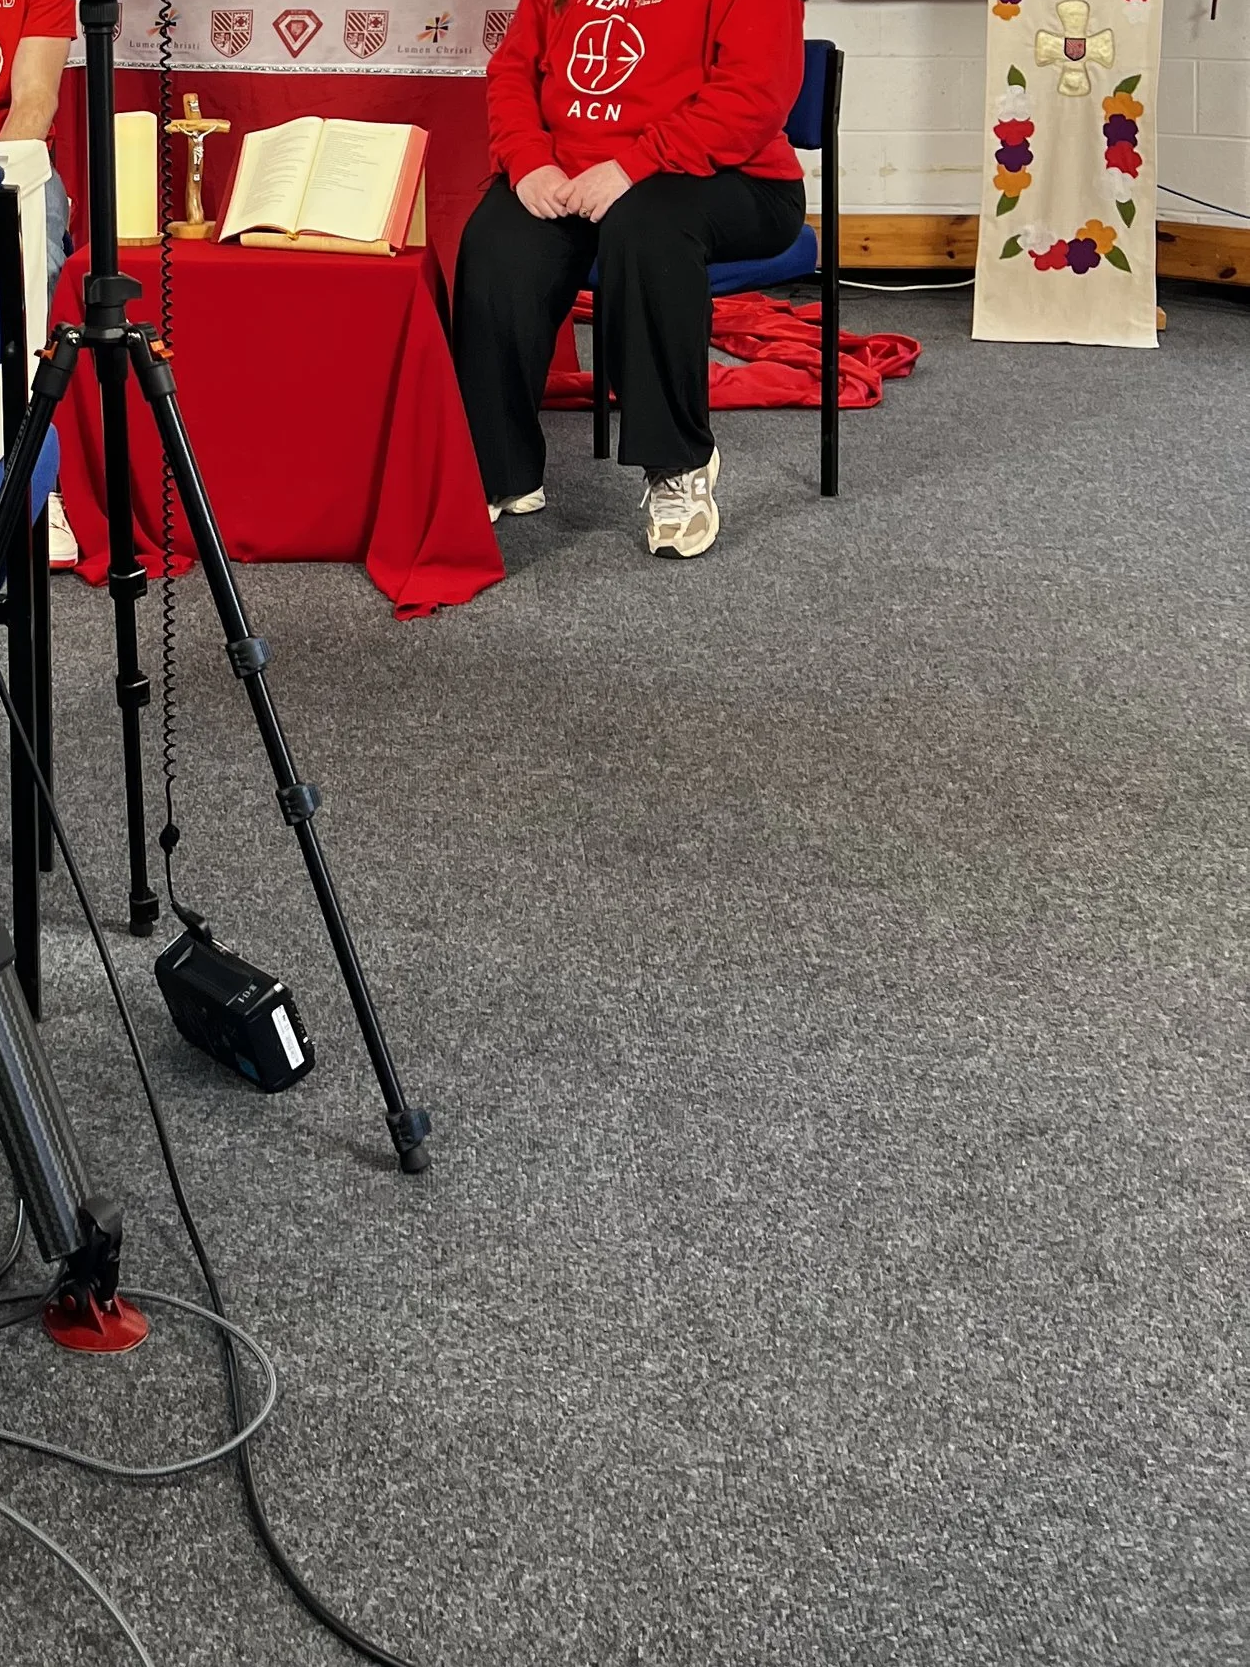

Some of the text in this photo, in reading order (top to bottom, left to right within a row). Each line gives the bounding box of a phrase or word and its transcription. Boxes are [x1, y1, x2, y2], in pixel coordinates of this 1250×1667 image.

[397, 45, 473, 55] Lumen Christi
[566, 100, 622, 123] ACN
